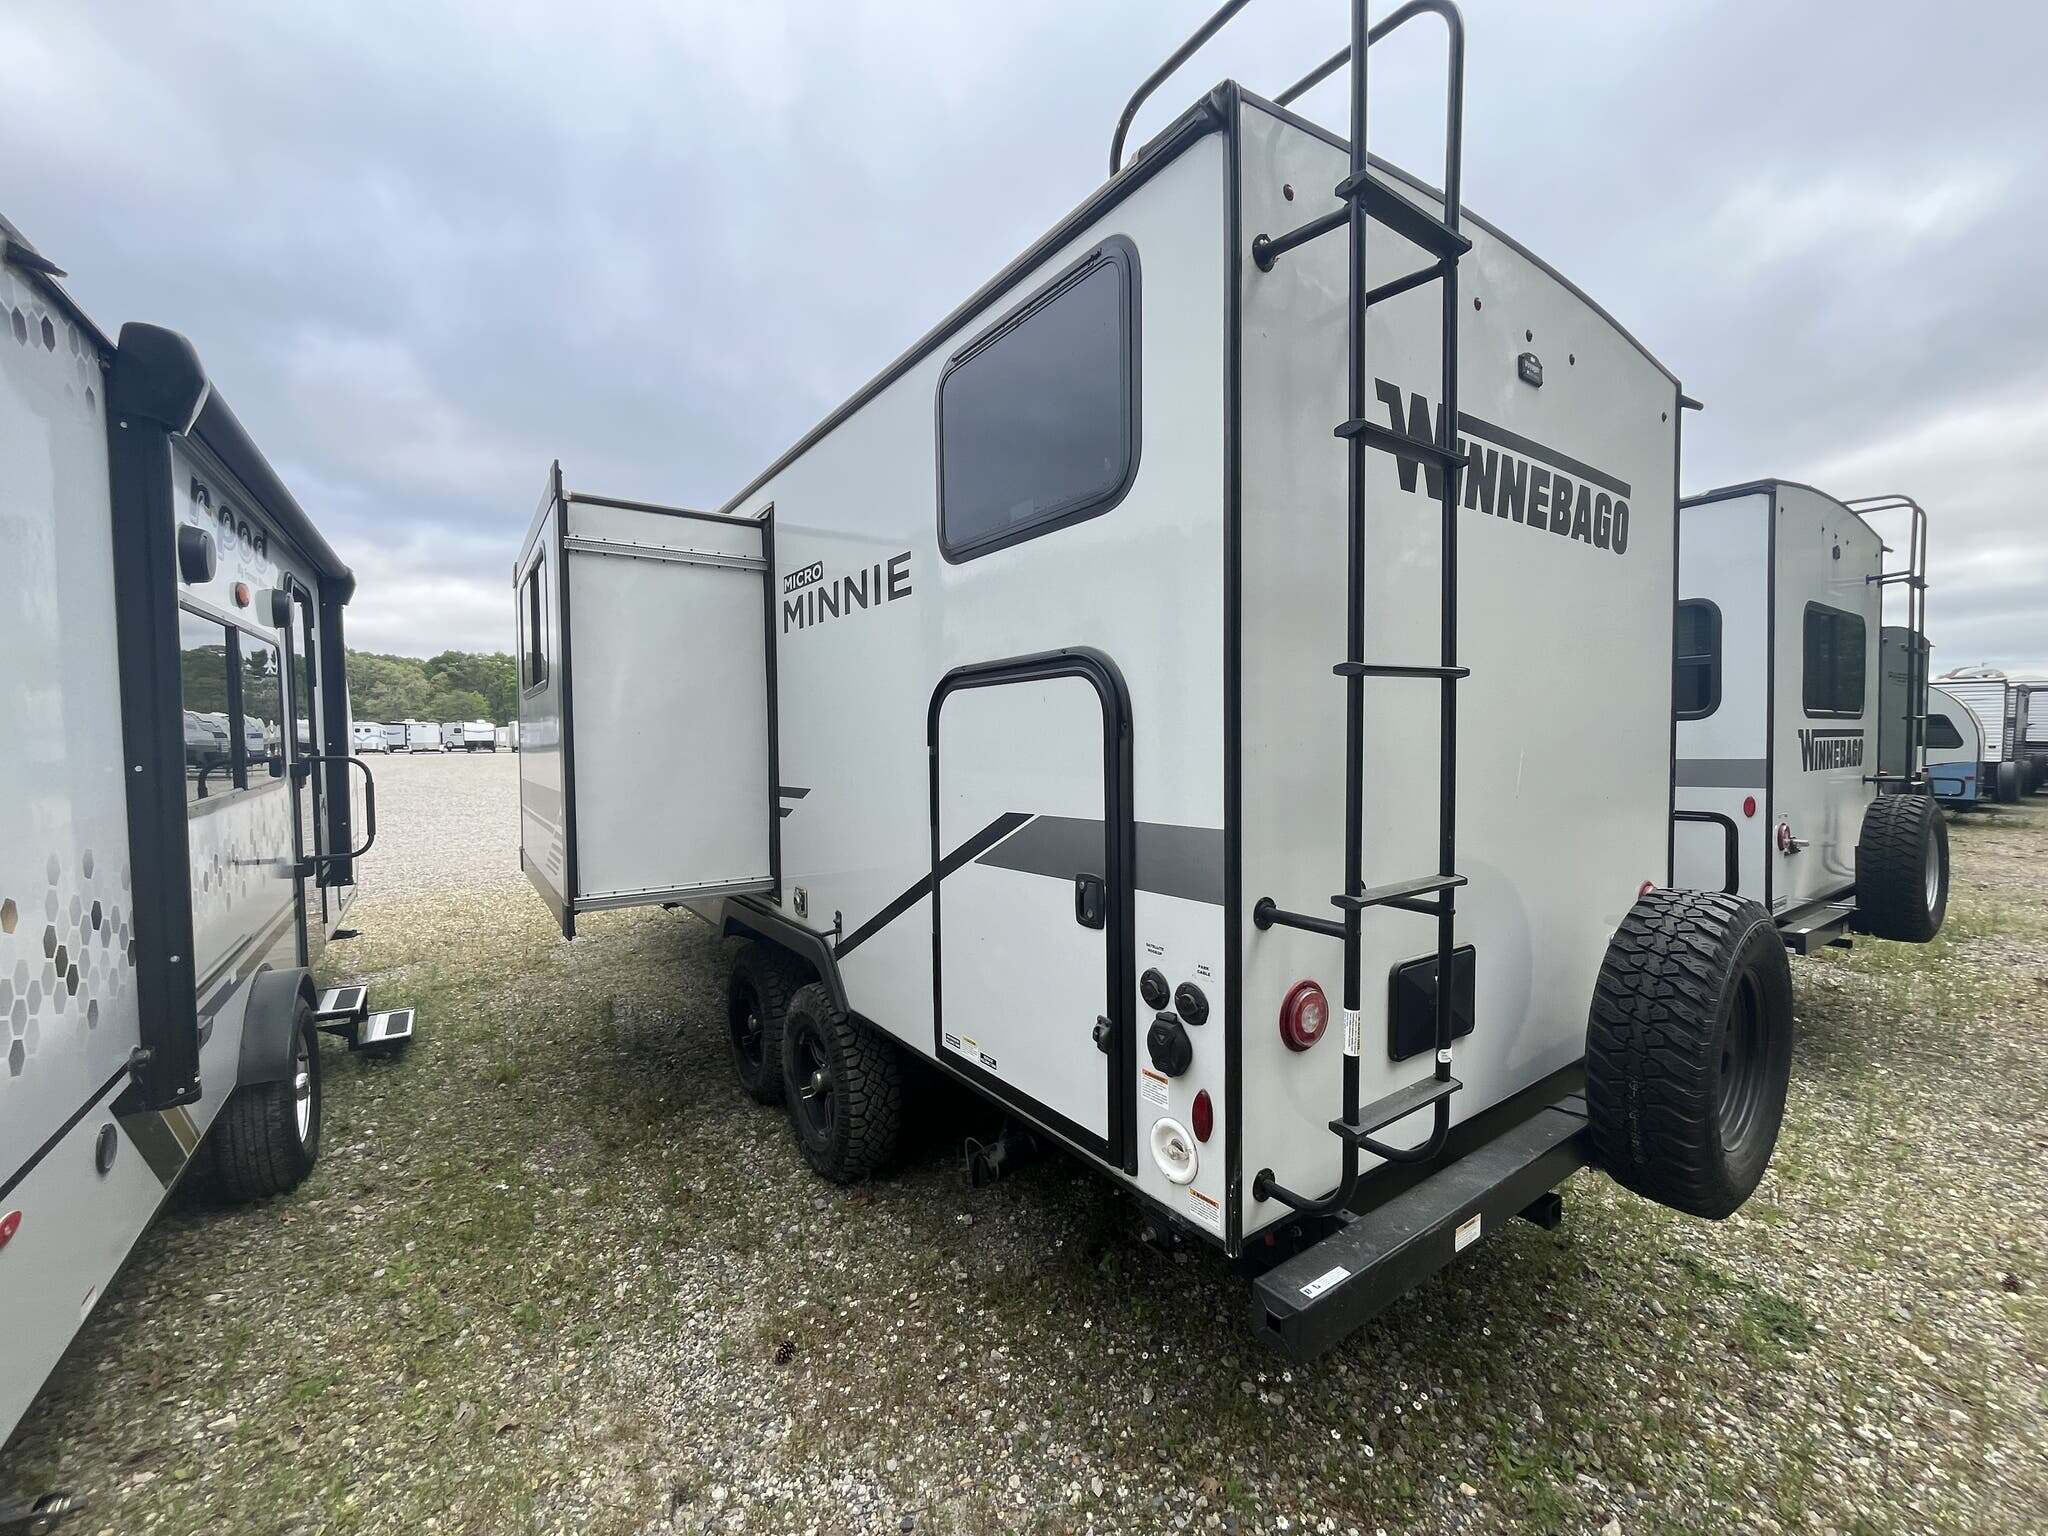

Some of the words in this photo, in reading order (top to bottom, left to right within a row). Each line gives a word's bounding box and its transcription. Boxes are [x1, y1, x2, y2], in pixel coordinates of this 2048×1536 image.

[783, 550, 913, 634] MINNIE
[784, 564, 823, 592] MICRO
[1797, 728, 1864, 772] WINNEBAGO
